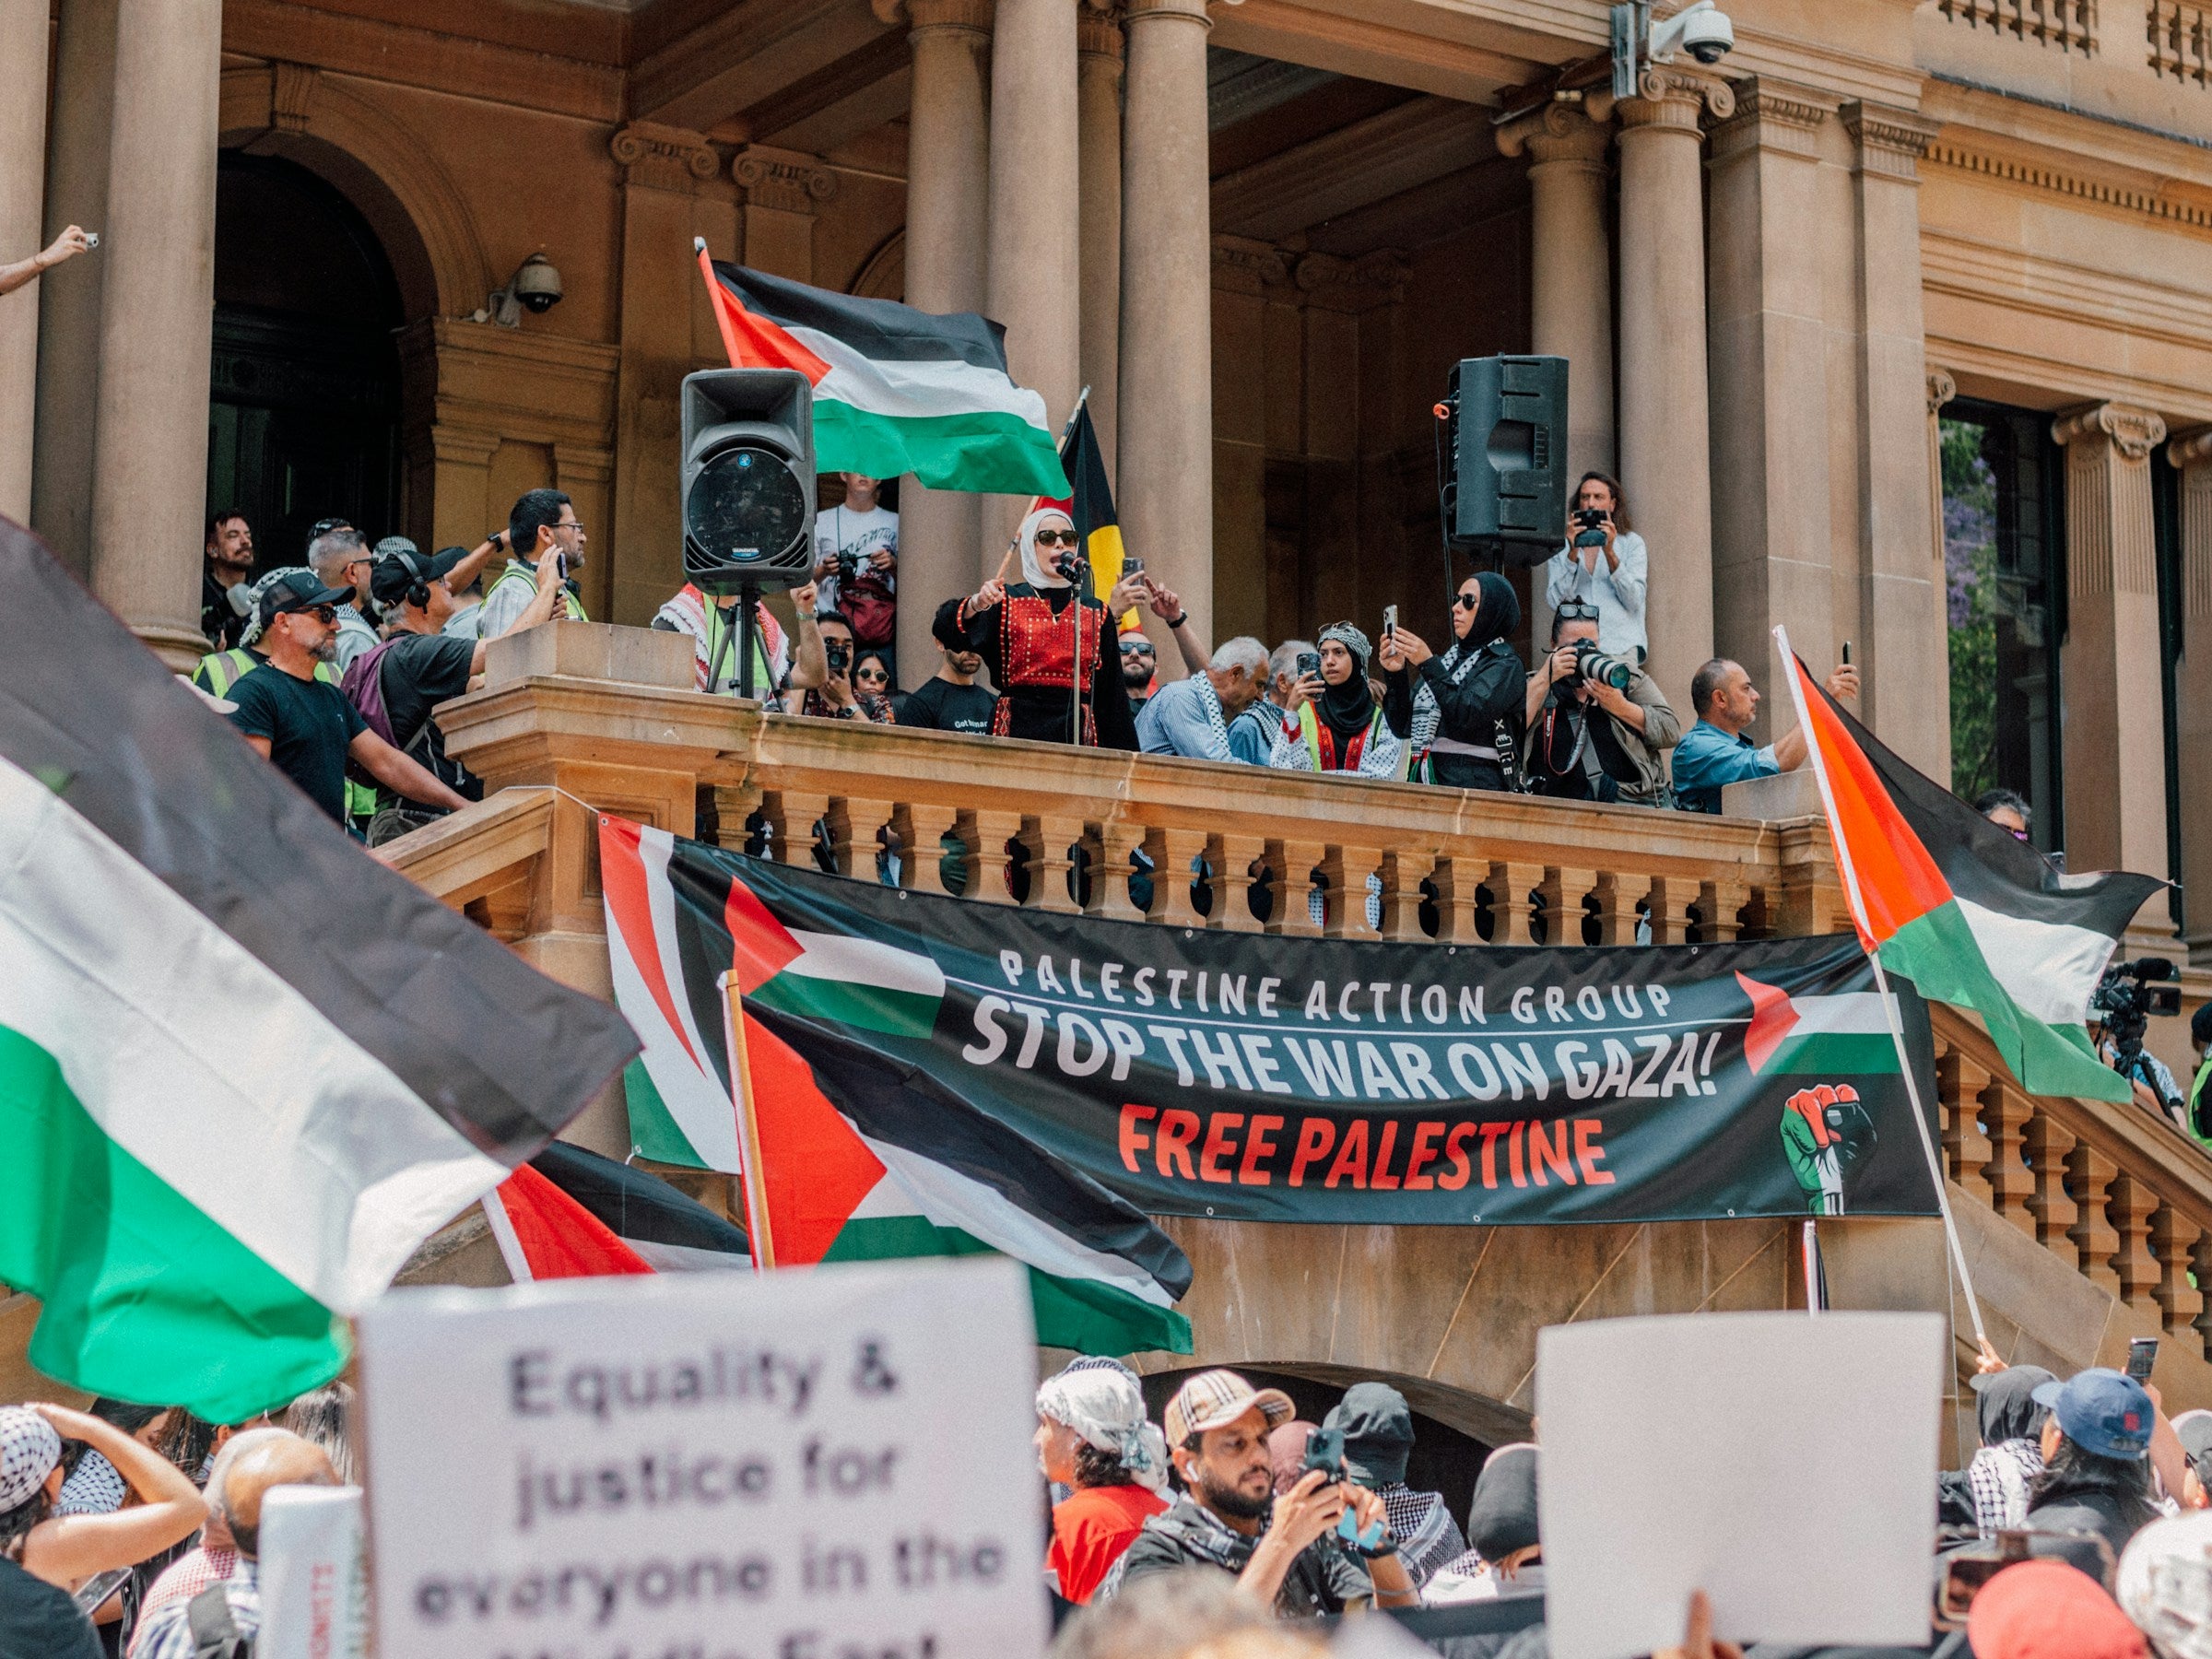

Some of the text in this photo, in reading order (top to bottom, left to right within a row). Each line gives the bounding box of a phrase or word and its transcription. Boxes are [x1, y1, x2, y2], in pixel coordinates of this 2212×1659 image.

[954, 719, 969, 728] Got
[999, 948, 1671, 1025] PALESTINE ACTION GROUP
[961, 994, 1722, 1101] STOP THE WAR ON GAZA!
[1118, 1103, 1617, 1191] FREE PALESTINE
[511, 1333, 898, 1425] Equality &
[516, 1434, 899, 1534] justice for
[417, 1558, 771, 1628] everyone
[801, 1530, 867, 1596] in
[895, 1526, 1006, 1591] the
